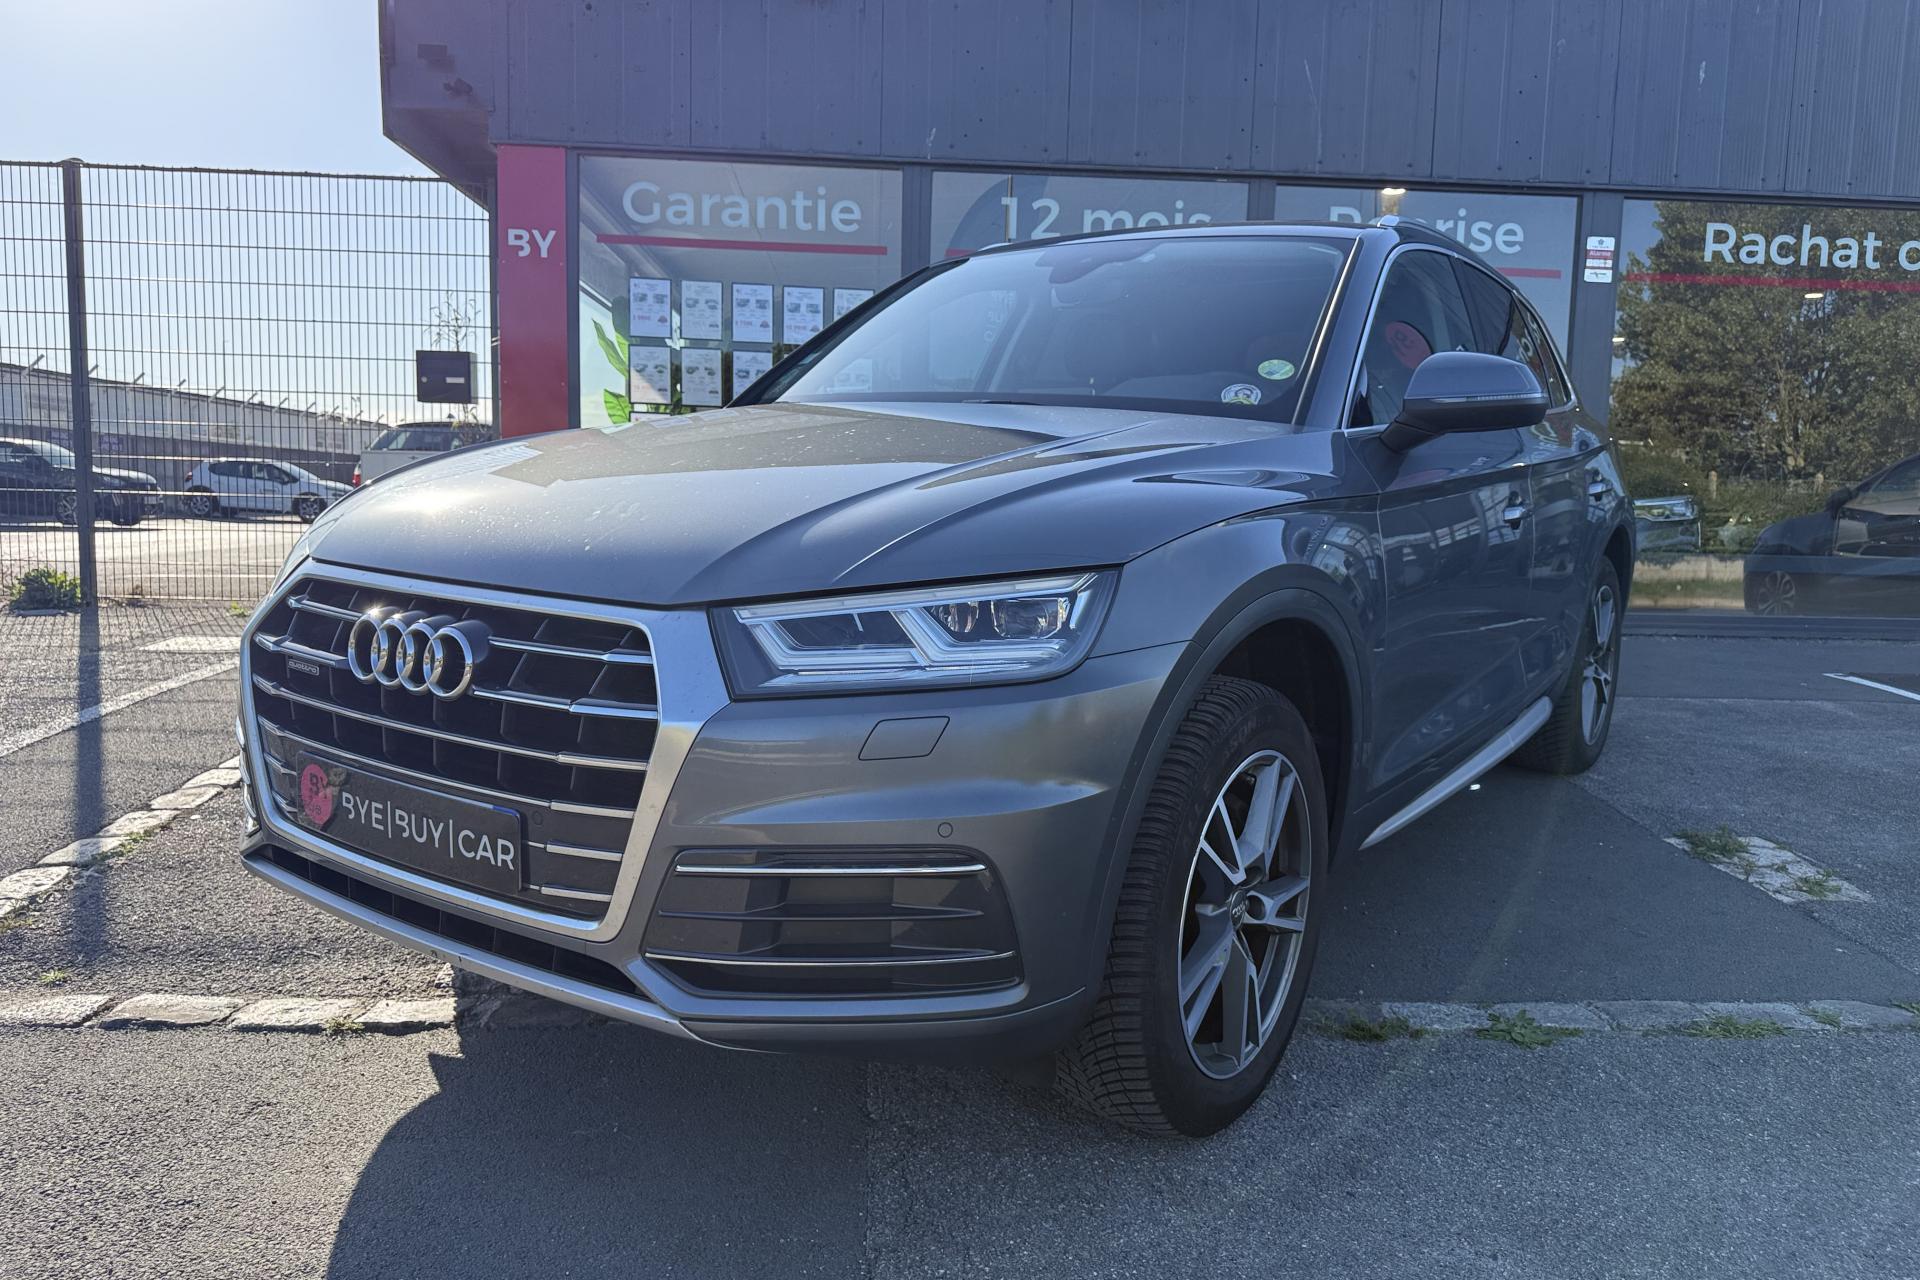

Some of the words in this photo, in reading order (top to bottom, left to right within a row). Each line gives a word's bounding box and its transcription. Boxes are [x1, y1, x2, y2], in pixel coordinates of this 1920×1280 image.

[622, 181, 862, 233] Garantie
[1001, 197, 1061, 240] 12
[1330, 206, 1524, 254] rise
[507, 229, 556, 258] BY
[1703, 222, 1883, 270] Rachat
